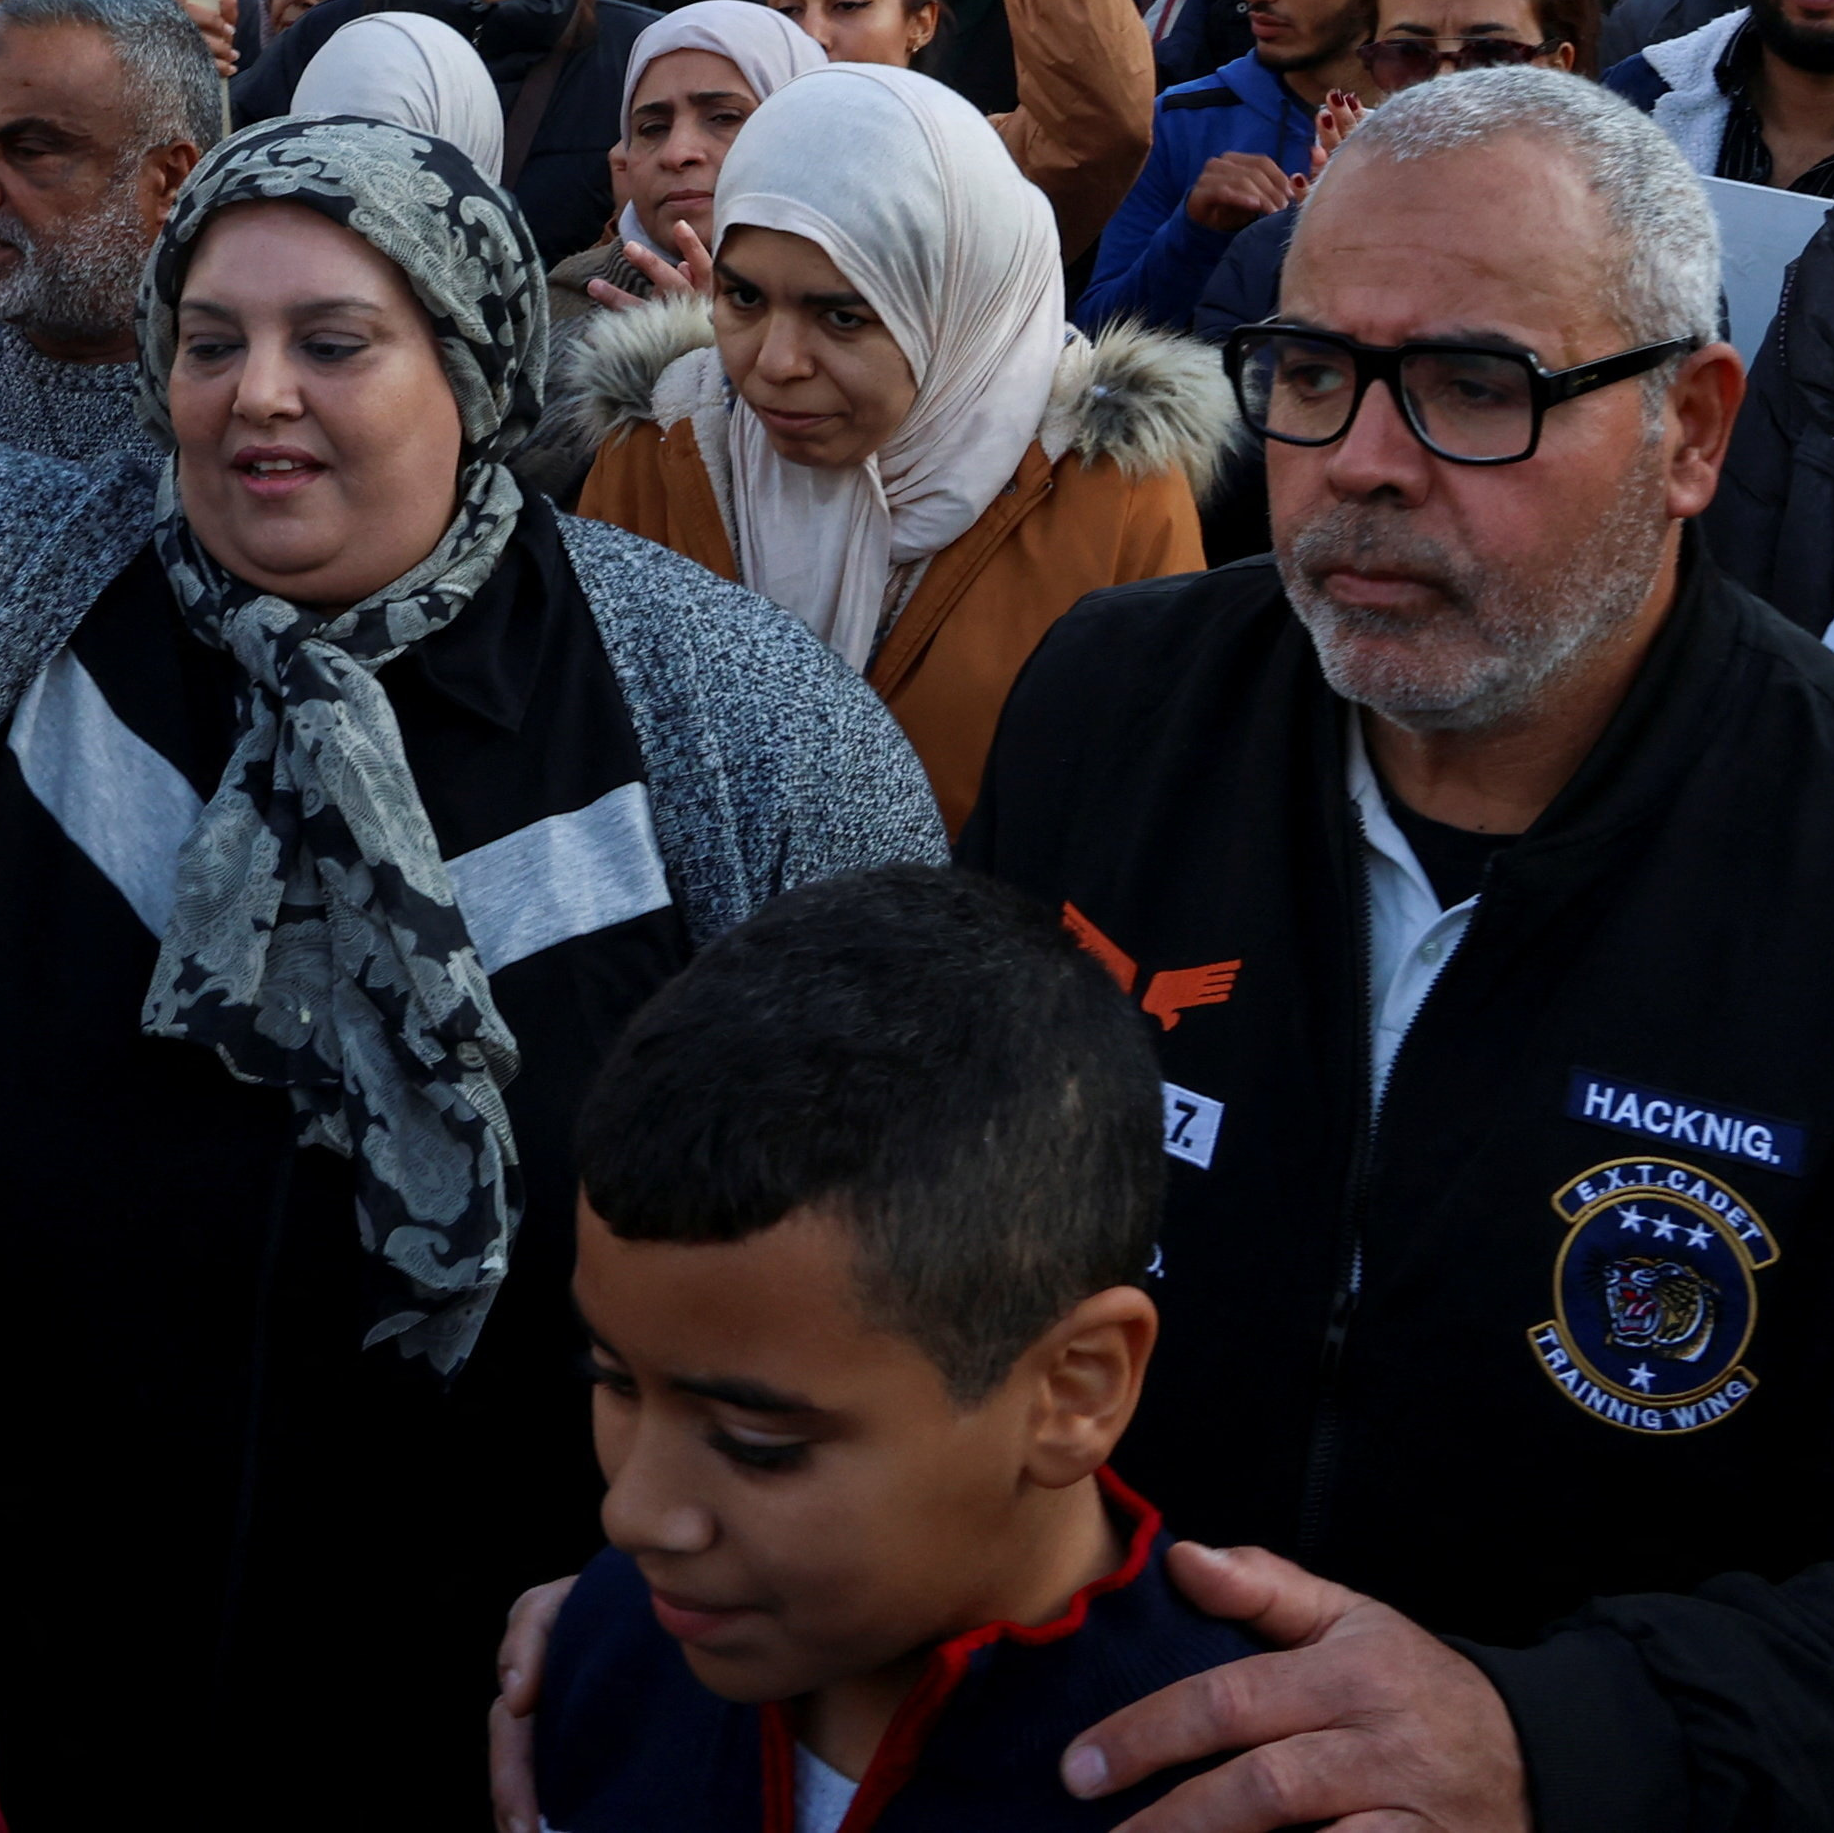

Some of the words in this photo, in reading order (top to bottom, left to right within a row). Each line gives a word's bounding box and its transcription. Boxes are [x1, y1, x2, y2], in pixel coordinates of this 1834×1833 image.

[1583, 1083, 1781, 1164] HACKNIG.
[1535, 1327, 1663, 1431] TRAINNIG
[1670, 1378, 1751, 1430] WING
